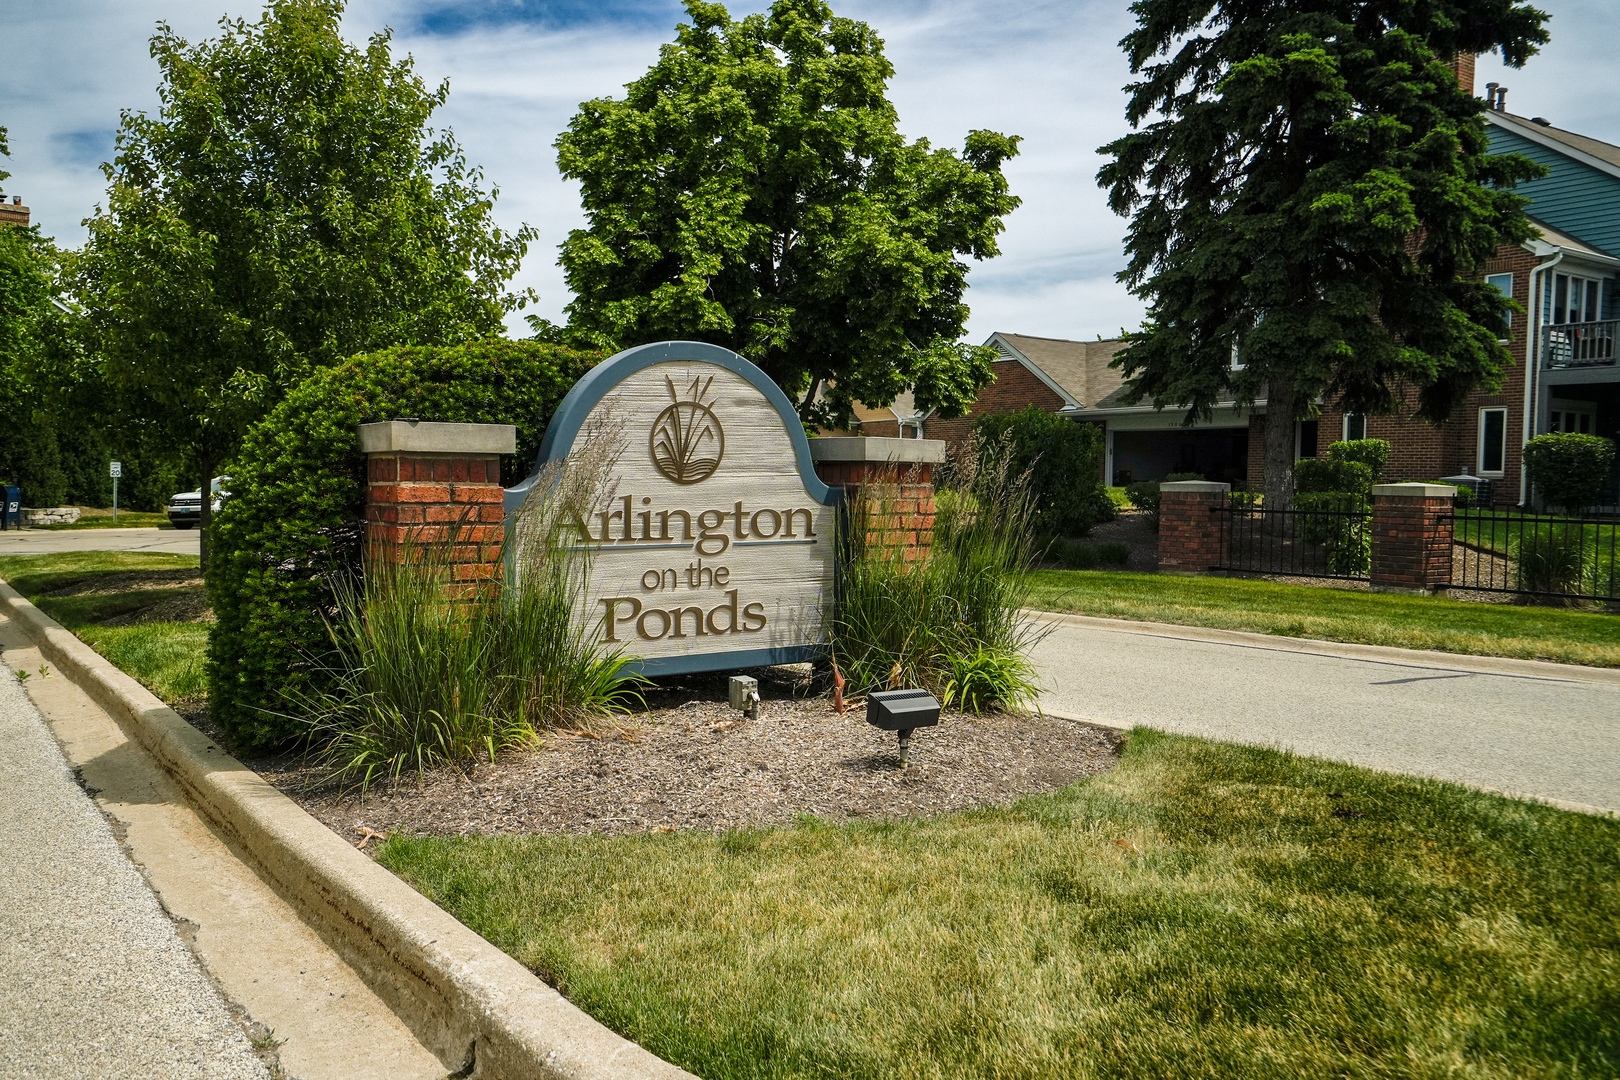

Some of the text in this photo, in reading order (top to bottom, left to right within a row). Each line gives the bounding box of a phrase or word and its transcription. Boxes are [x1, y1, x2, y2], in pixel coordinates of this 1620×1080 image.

[642, 558, 730, 591] on the
[598, 588, 767, 644] Ponds
